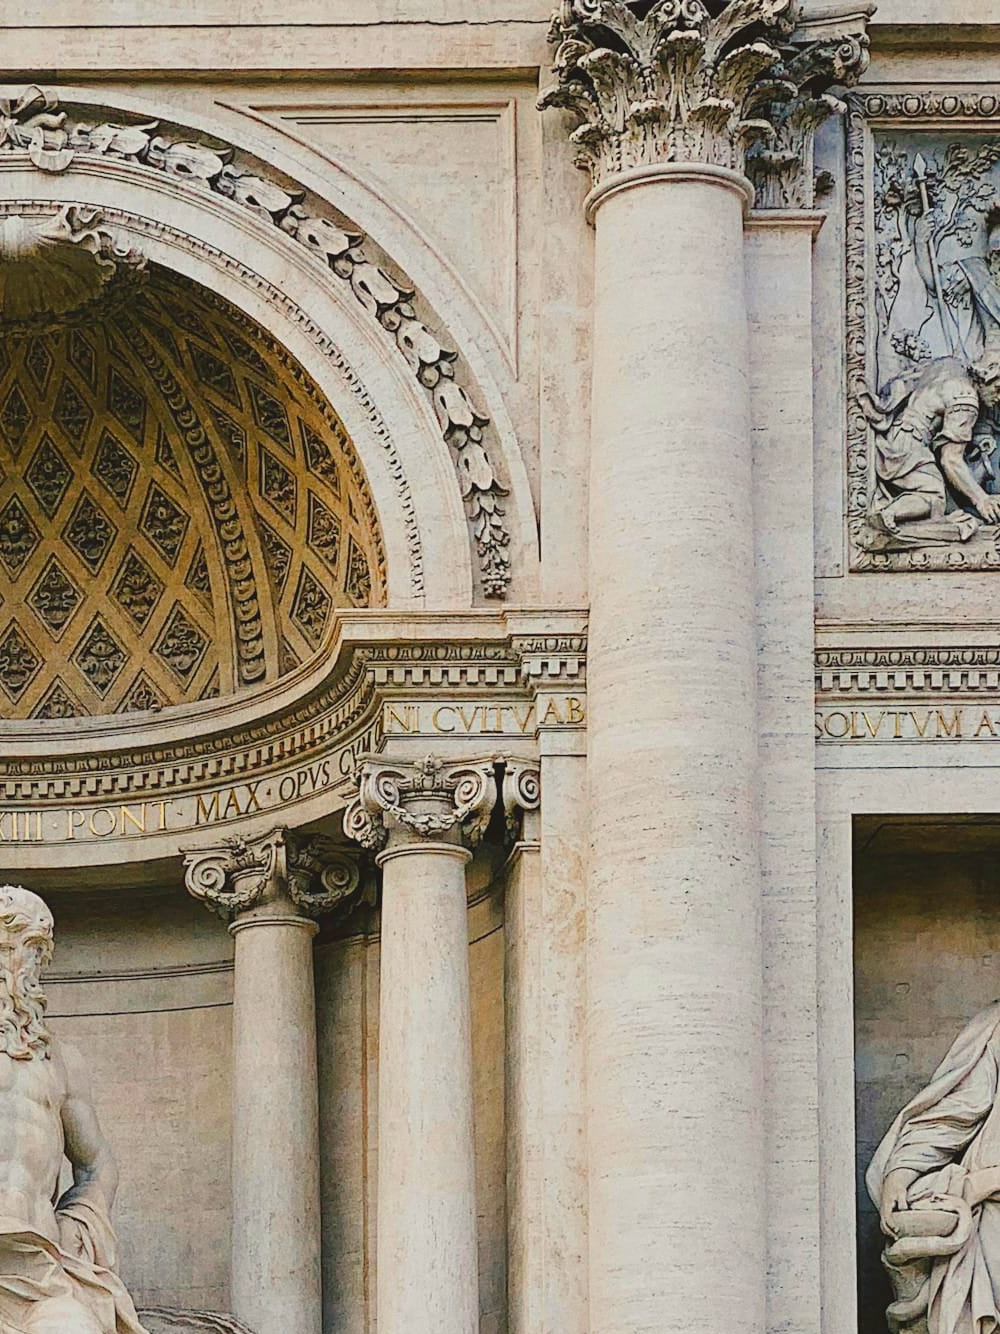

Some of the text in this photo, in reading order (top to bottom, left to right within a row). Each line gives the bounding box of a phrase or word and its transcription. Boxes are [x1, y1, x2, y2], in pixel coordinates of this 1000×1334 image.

[66, 799, 173, 841] PONT
[195, 779, 263, 826] MAX
[278, 760, 330, 802] OPVS
